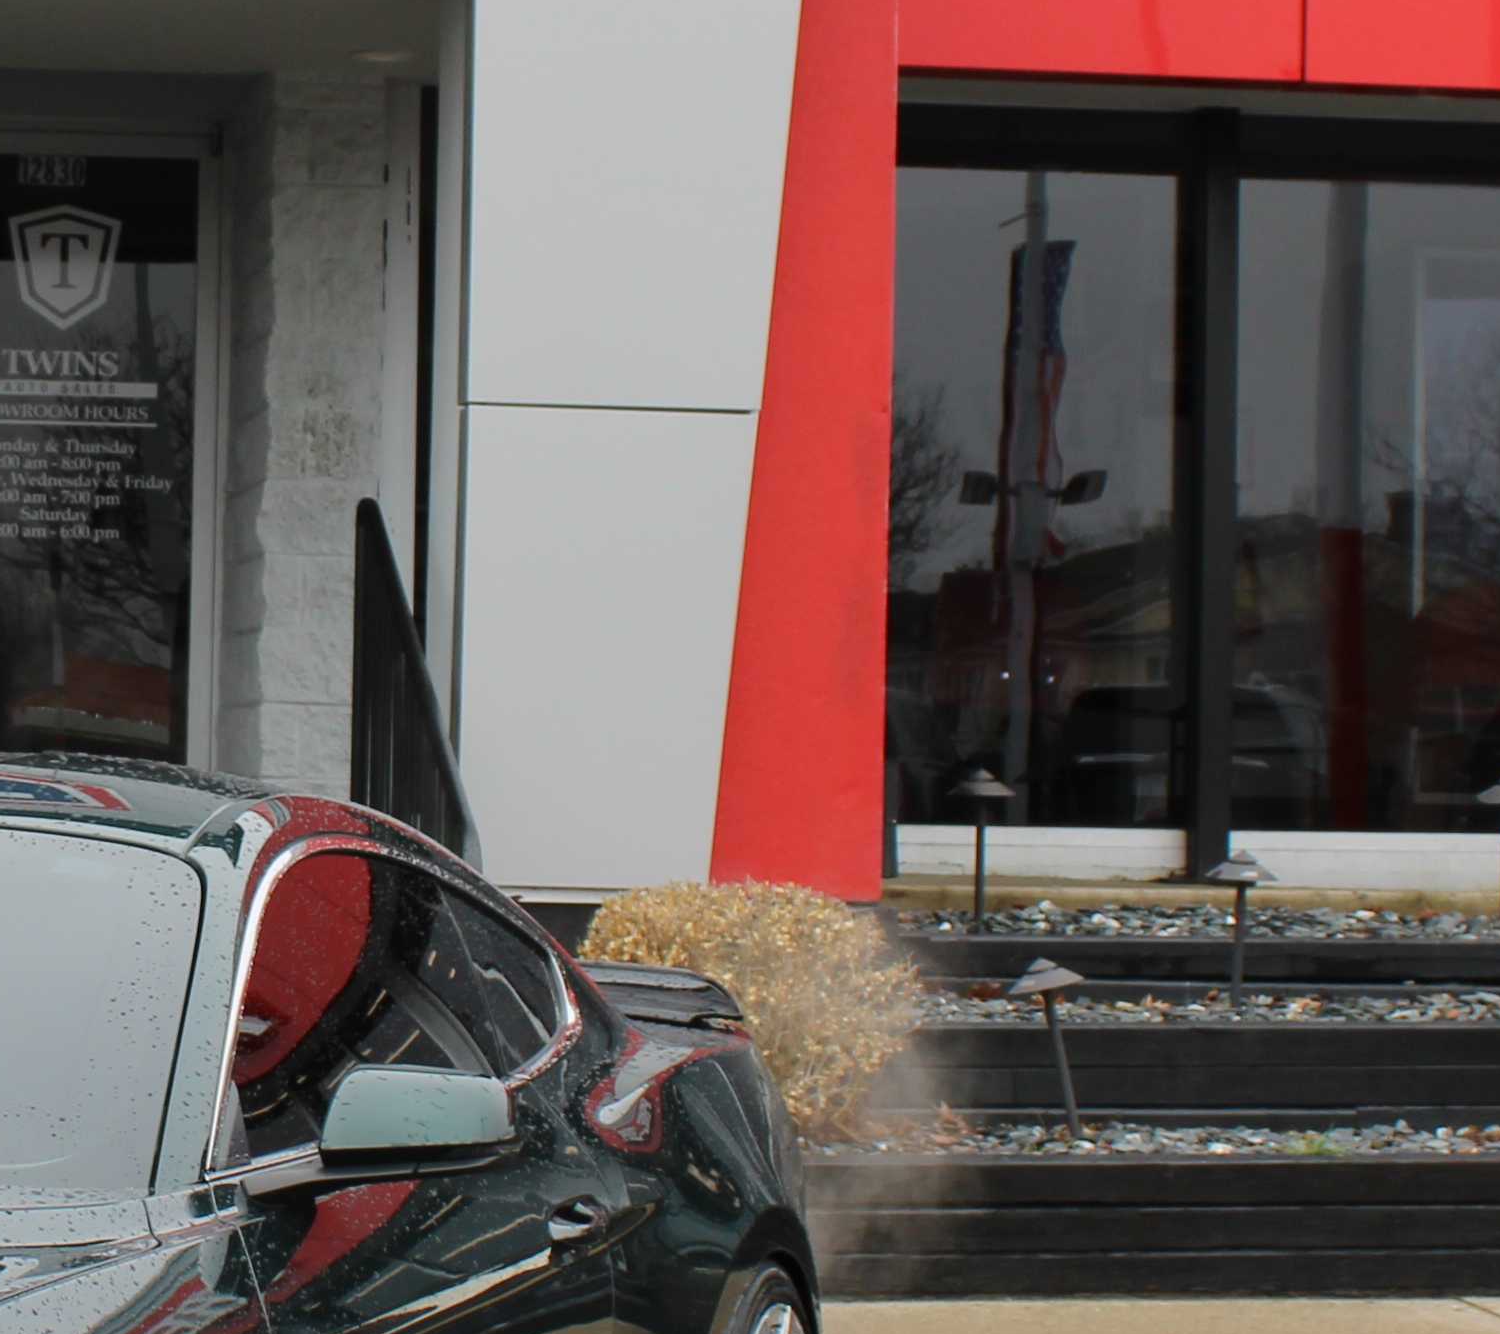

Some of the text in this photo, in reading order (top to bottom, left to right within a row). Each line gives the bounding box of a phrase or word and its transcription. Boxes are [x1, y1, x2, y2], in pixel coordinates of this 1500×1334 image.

[40, 233, 90, 288] T
[2, 349, 120, 377] TWINS
[3, 382, 116, 394] AUTO SALES
[84, 405, 150, 421] HOURS
[45, 439, 59, 453] &
[64, 438, 137, 459] Thursday
[23, 459, 48, 469] am
[61, 457, 92, 469] 8:00
[94, 460, 121, 475] pm
[11, 471, 100, 489] Wednesday
[105, 475, 119, 488] &
[124, 475, 173, 493] Friday
[23, 494, 48, 504] am
[61, 491, 91, 504] 7:00
[94, 495, 121, 509] pm
[19, 505, 90, 523] Saturday
[23, 528, 48, 539] am
[59, 525, 90, 539] 6:00
[93, 529, 120, 543] pm
